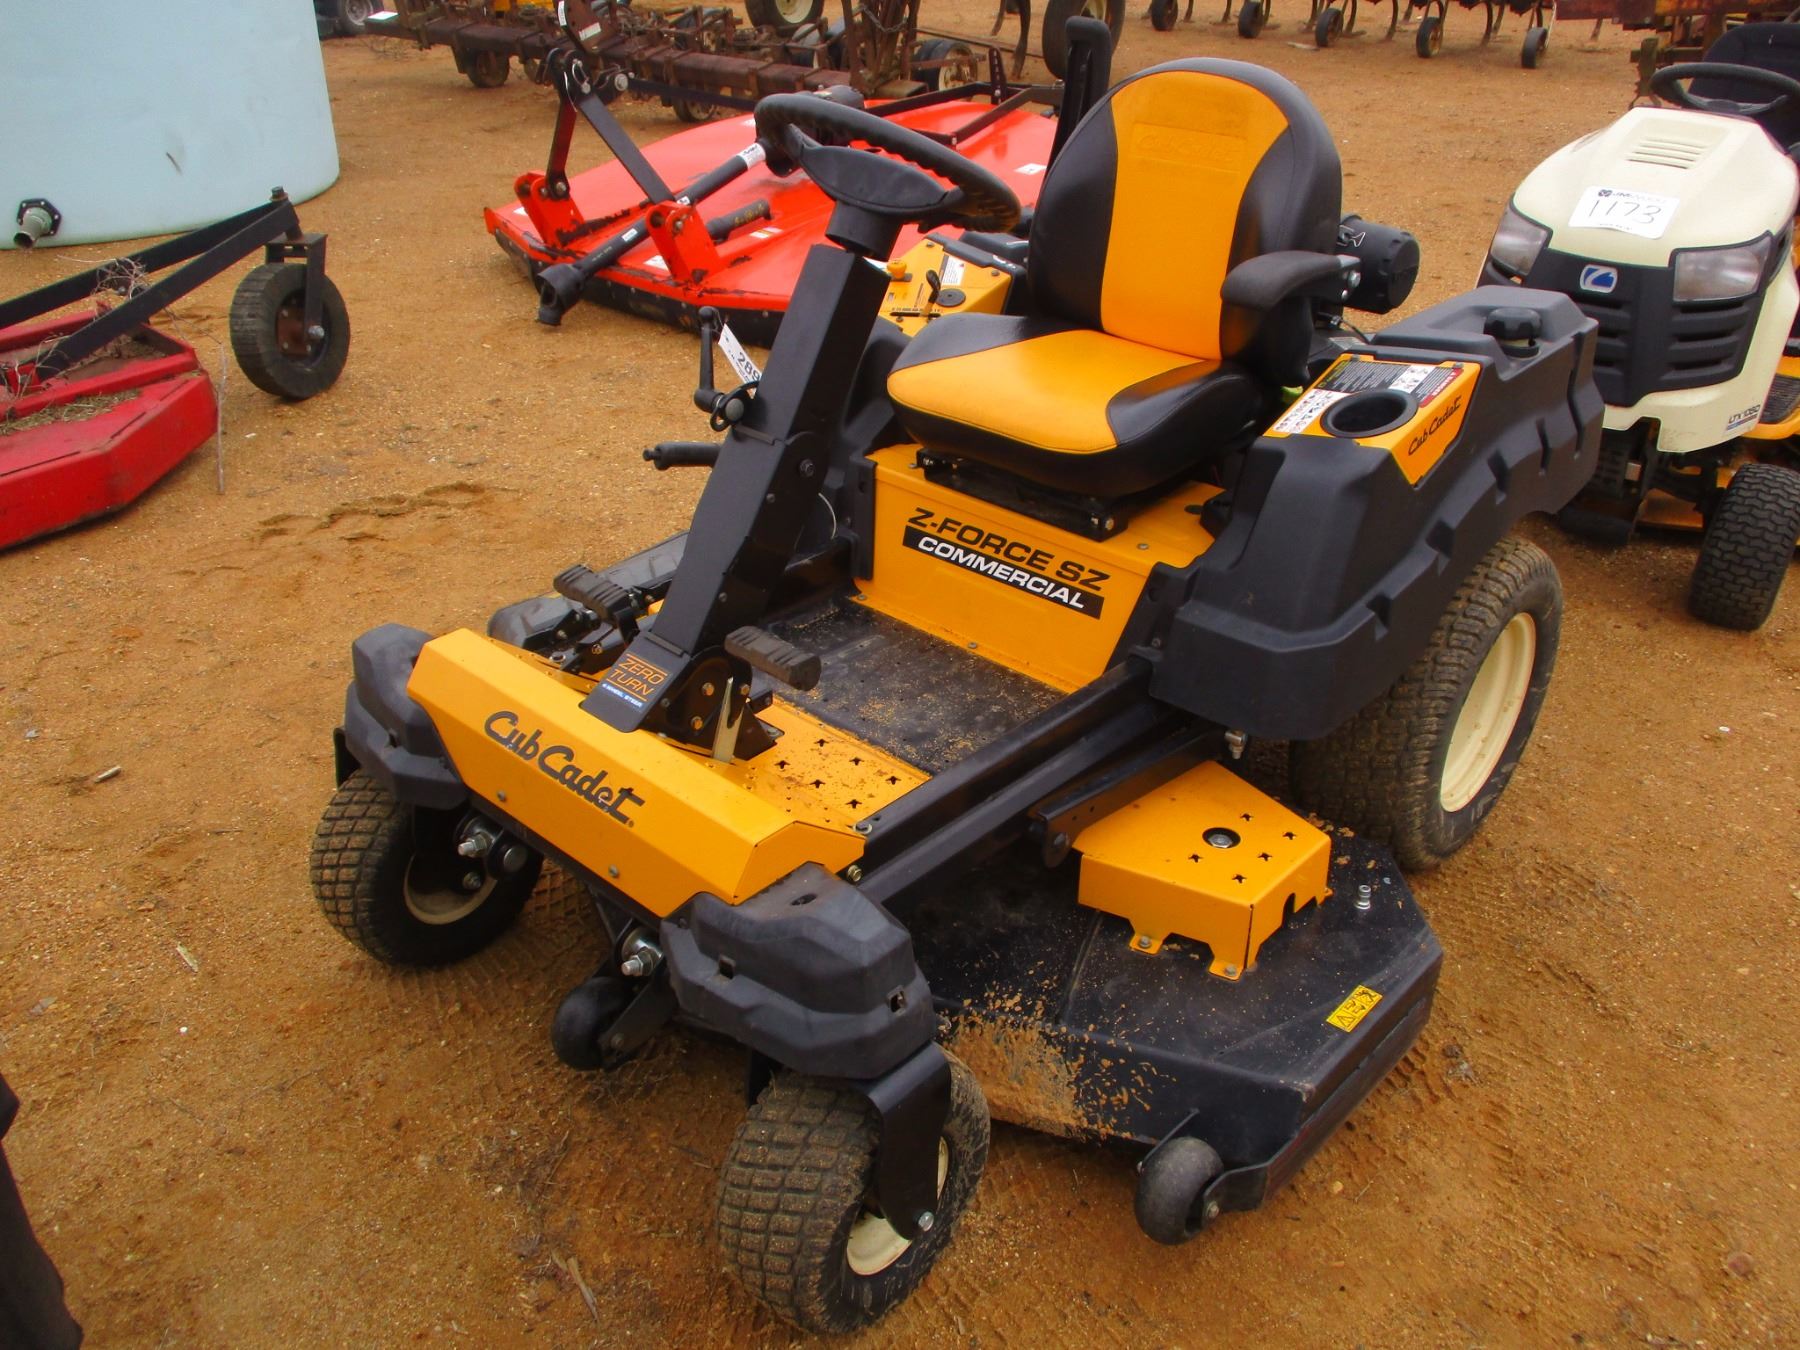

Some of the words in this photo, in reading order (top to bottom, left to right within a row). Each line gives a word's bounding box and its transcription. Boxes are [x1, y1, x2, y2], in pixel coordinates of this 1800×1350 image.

[1588, 199, 1661, 224] 1173
[1408, 428, 1428, 456] Cub
[1429, 395, 1462, 435] Cadet
[908, 507, 1055, 571] Z-FORCE
[1055, 560, 1111, 591] SZ
[918, 536, 1085, 609] COMMERCIAL
[610, 668, 655, 695] TURN
[619, 658, 665, 685] ZERO
[484, 710, 543, 761] Cub
[537, 745, 646, 825] Cadet
